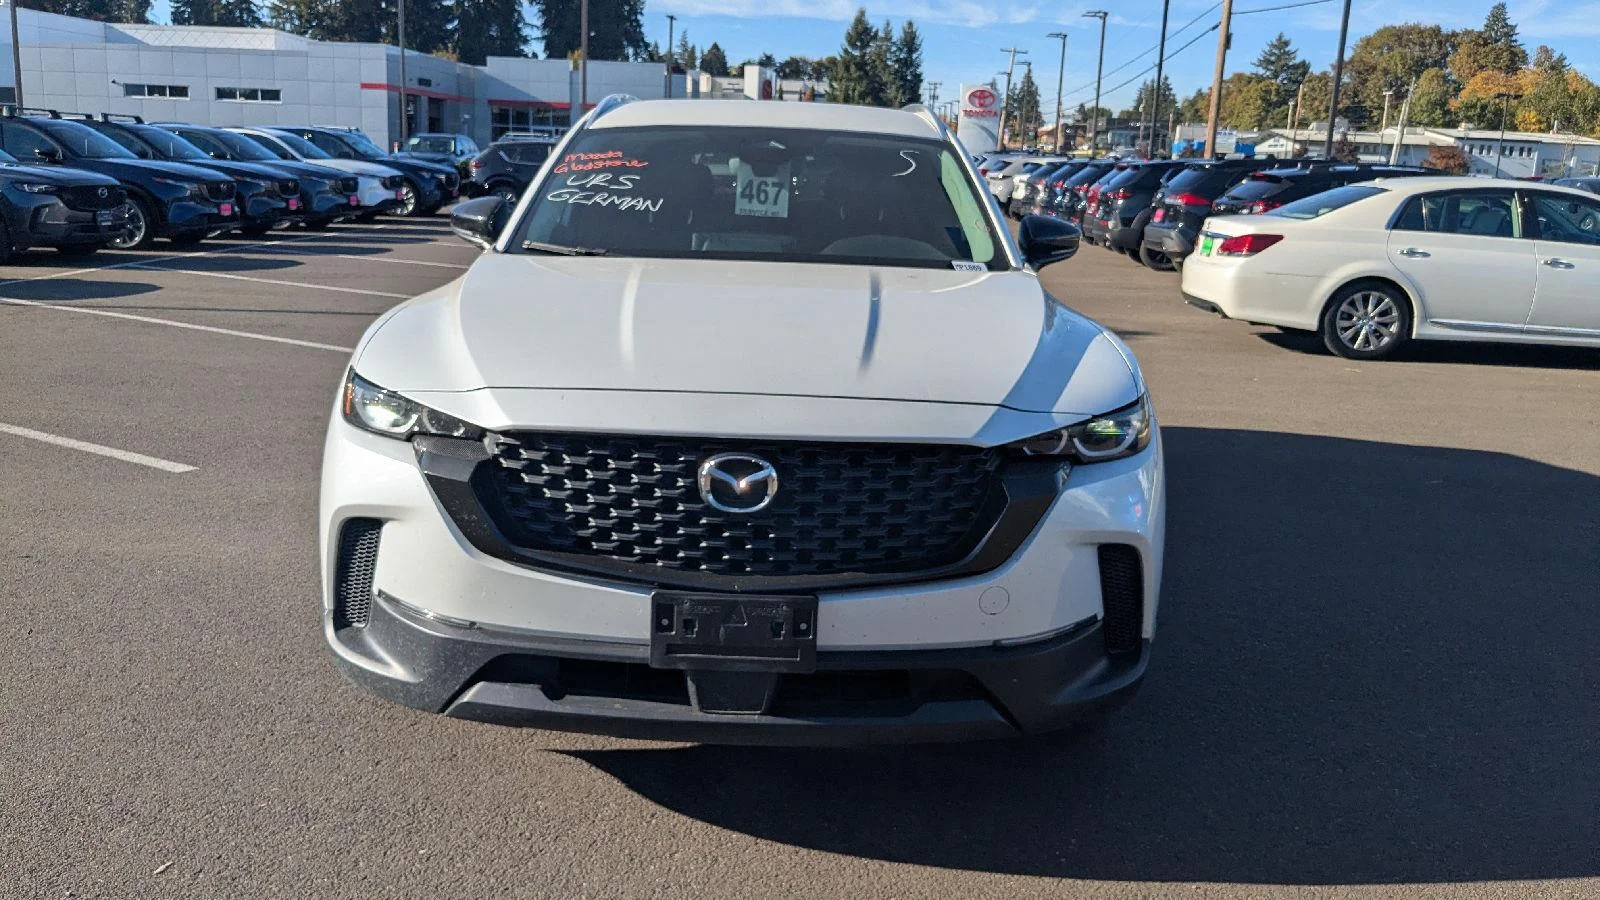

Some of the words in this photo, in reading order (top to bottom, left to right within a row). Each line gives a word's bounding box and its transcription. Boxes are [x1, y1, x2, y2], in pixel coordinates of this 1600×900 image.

[566, 173, 641, 189] URS
[547, 189, 664, 212] GERMAN
[740, 180, 784, 206] 467
